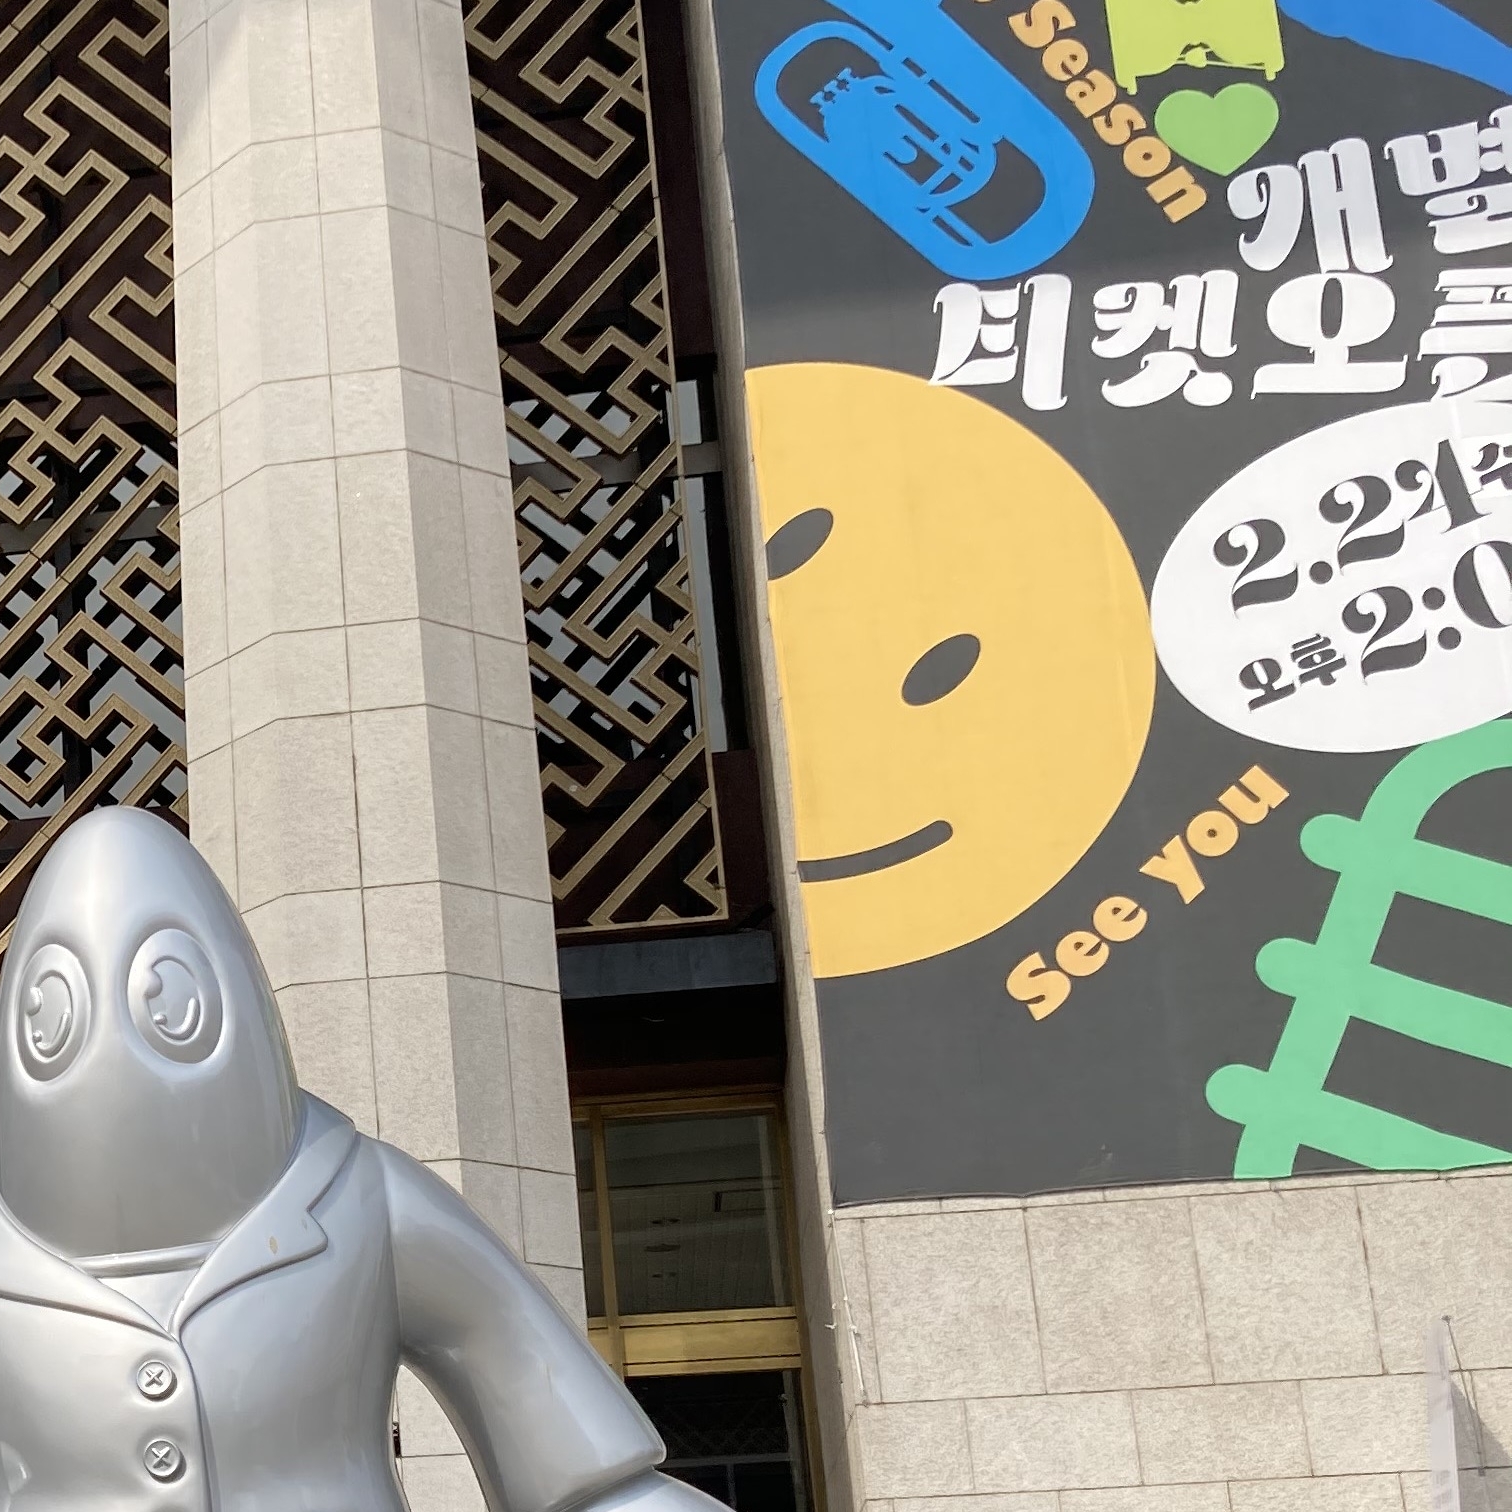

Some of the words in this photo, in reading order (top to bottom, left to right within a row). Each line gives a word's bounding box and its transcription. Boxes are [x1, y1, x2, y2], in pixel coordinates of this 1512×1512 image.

[1007, 0, 1207, 224] Season
[1239, 632, 1347, 713] 오후
[1005, 896, 1148, 1022] See
[1138, 764, 1290, 905] you
